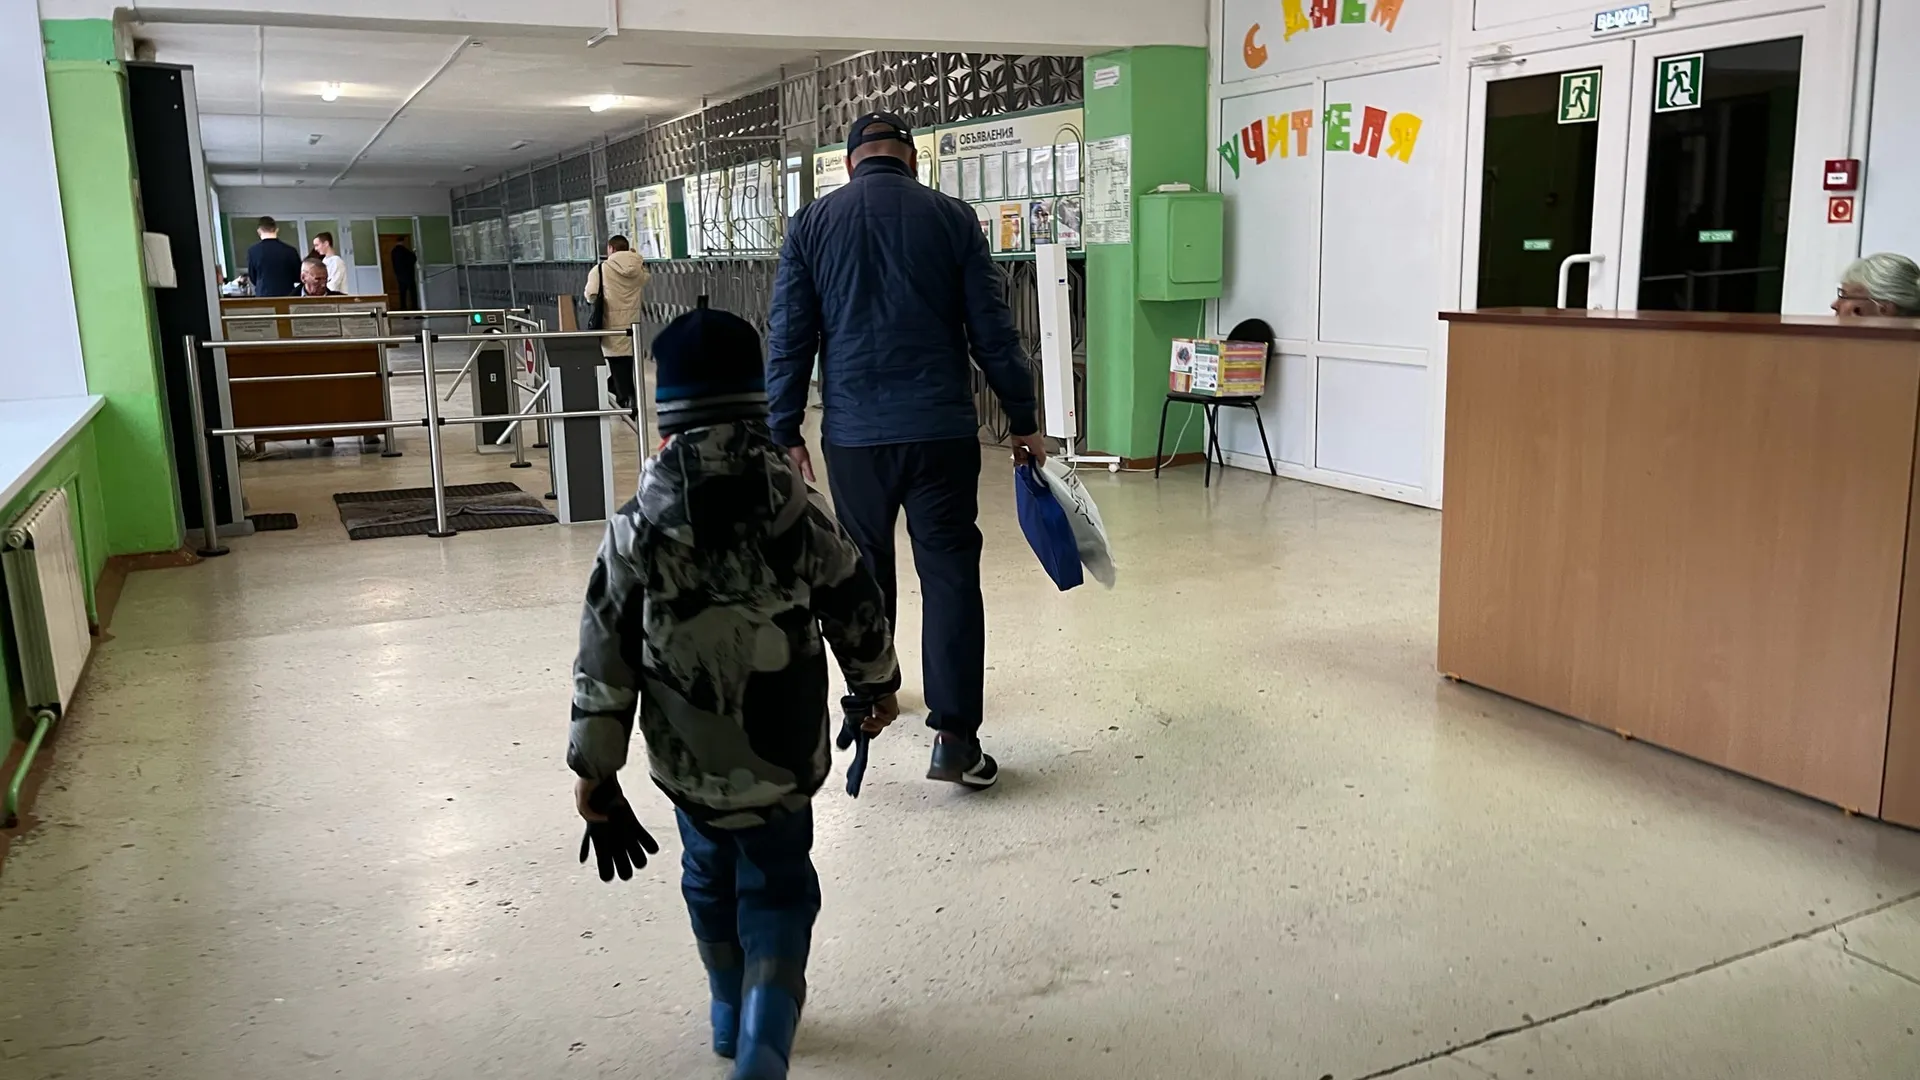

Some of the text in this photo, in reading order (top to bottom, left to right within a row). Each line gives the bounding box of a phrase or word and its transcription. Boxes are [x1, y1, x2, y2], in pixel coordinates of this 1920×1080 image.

[1596, 5, 1649, 31] ВЫХОД
[1243, 22, 1269, 70] С
[959, 126, 1014, 145] ОБЪЯВЛЕНИЯ
[1216, 102, 1424, 181] УЧИТЕЛЯ
